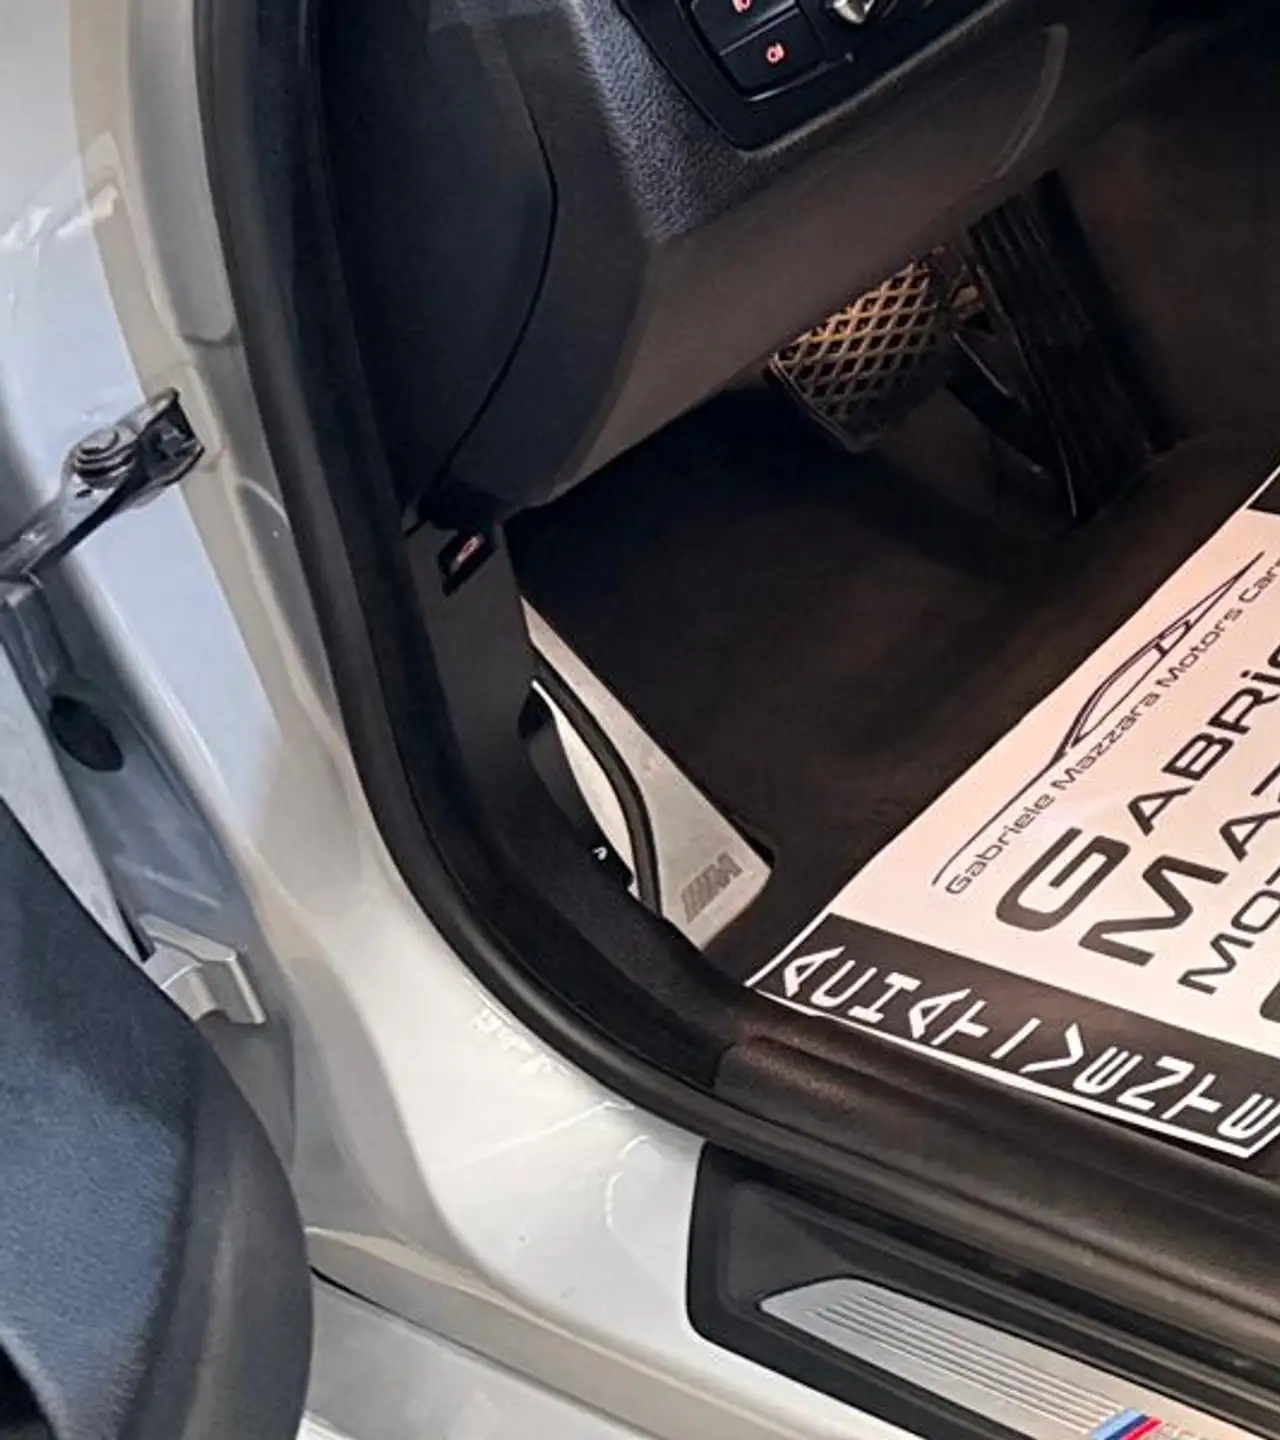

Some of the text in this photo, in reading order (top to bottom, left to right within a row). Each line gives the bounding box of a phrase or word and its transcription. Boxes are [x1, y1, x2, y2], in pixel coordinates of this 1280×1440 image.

[946, 793, 1055, 895] Gabriele
[1050, 692, 1160, 790] Mazzara
[1156, 608, 1242, 688] Motors
